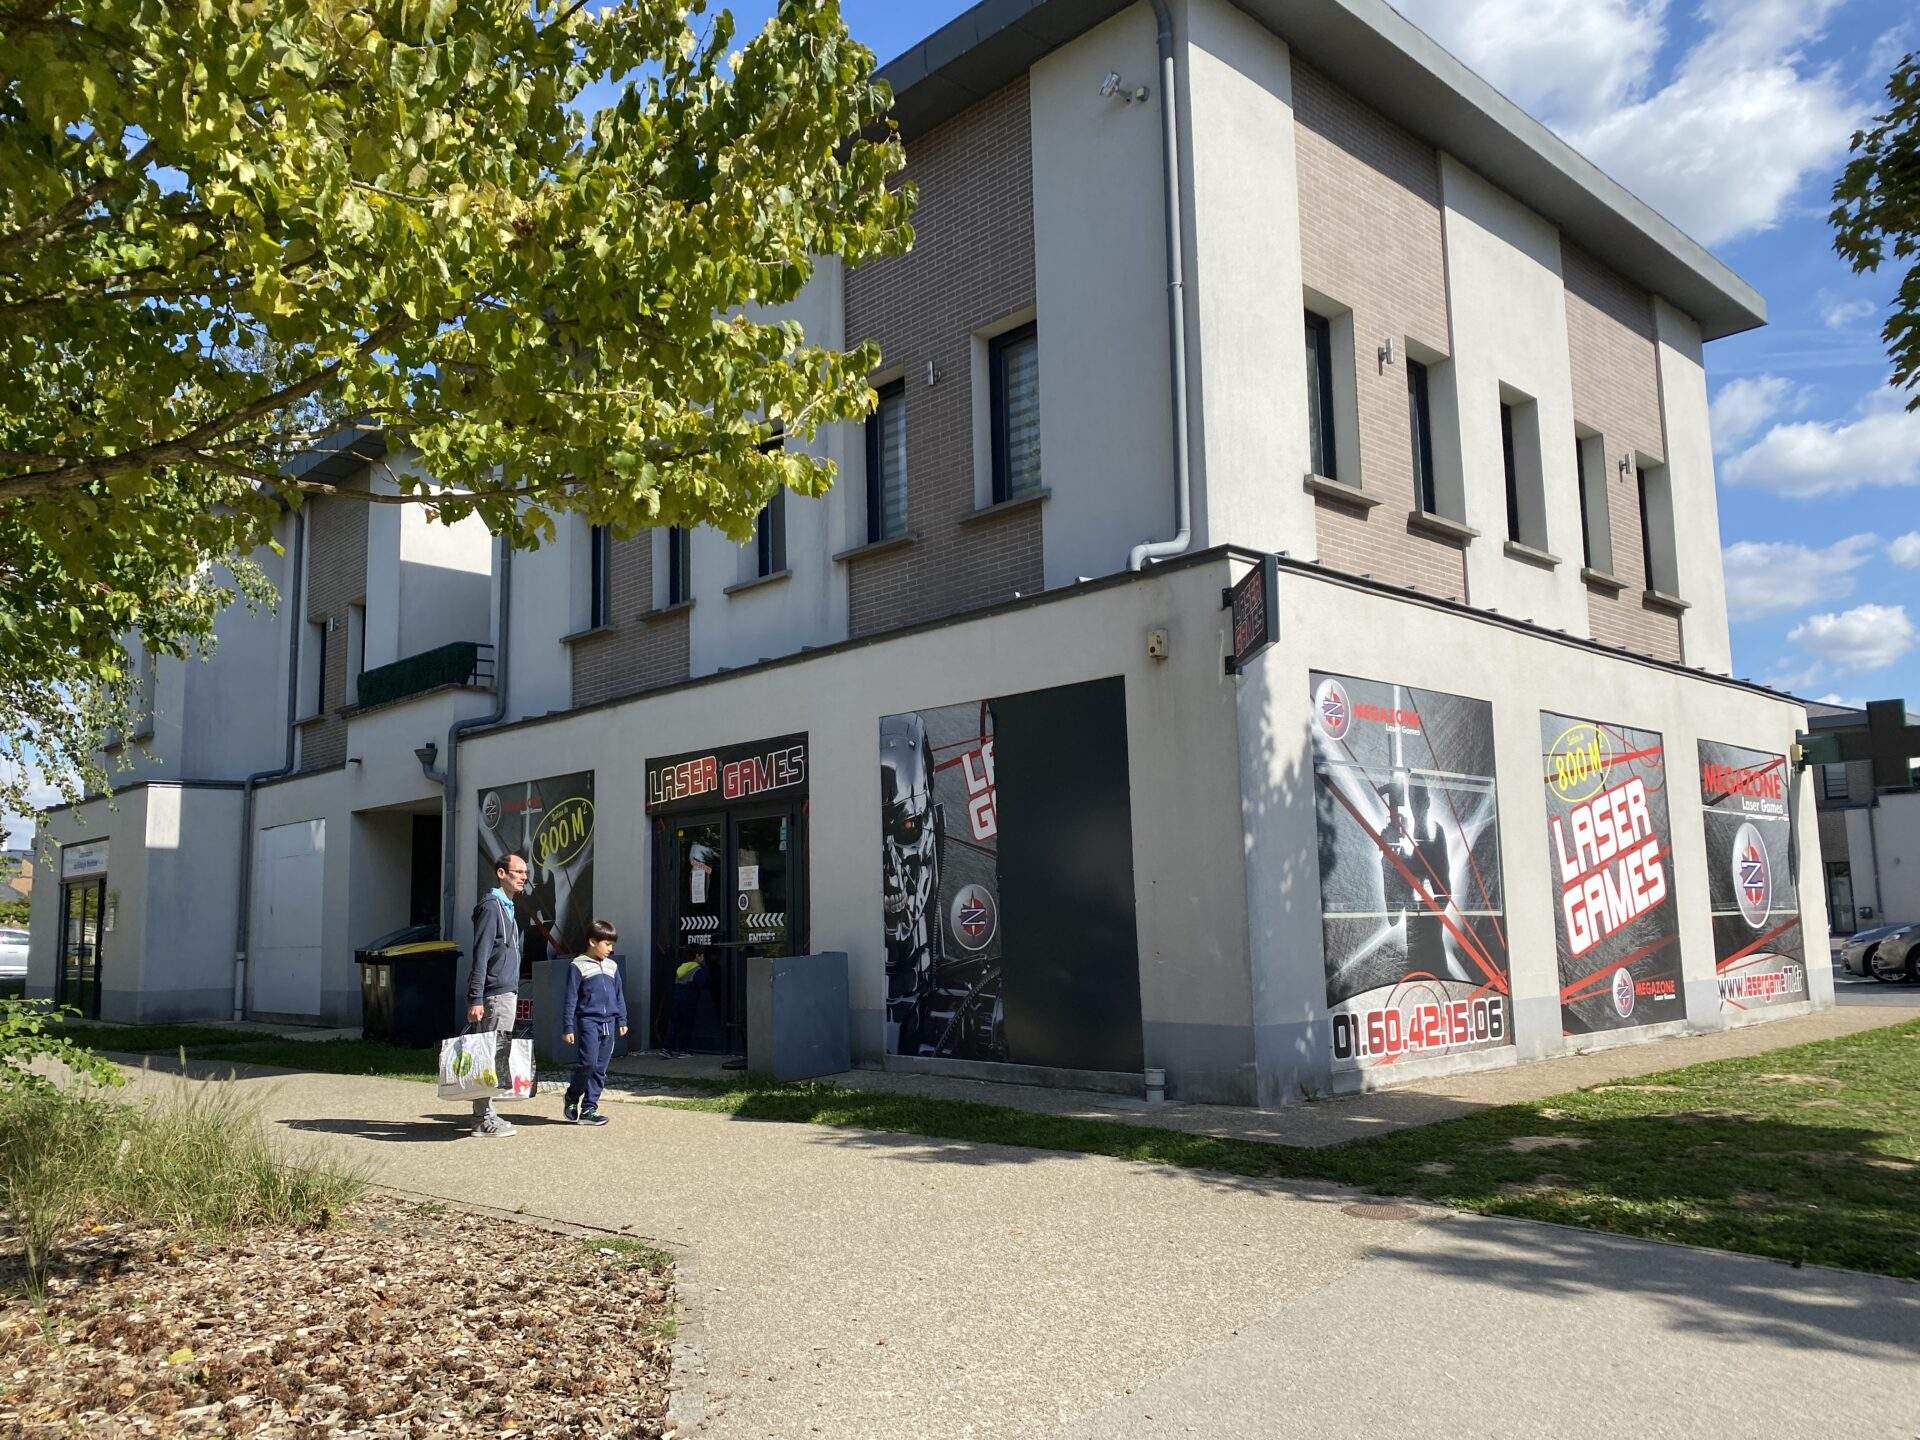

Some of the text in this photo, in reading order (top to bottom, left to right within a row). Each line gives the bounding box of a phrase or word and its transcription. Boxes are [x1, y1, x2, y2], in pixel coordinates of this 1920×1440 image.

[649, 745, 805, 805] LASER GAMES
[1556, 746, 1587, 791] 800
[1703, 762, 1782, 800] MEGAZONE
[1742, 796, 1784, 814] Laser Games
[539, 819, 570, 860] 800
[1551, 778, 1653, 885] LASER
[1563, 839, 1667, 956] GAMES
[687, 932, 712, 946] ENTRÉE
[1635, 981, 1676, 995] MEGAZONE
[1332, 997, 1504, 1061] 01.60.42.15.06
